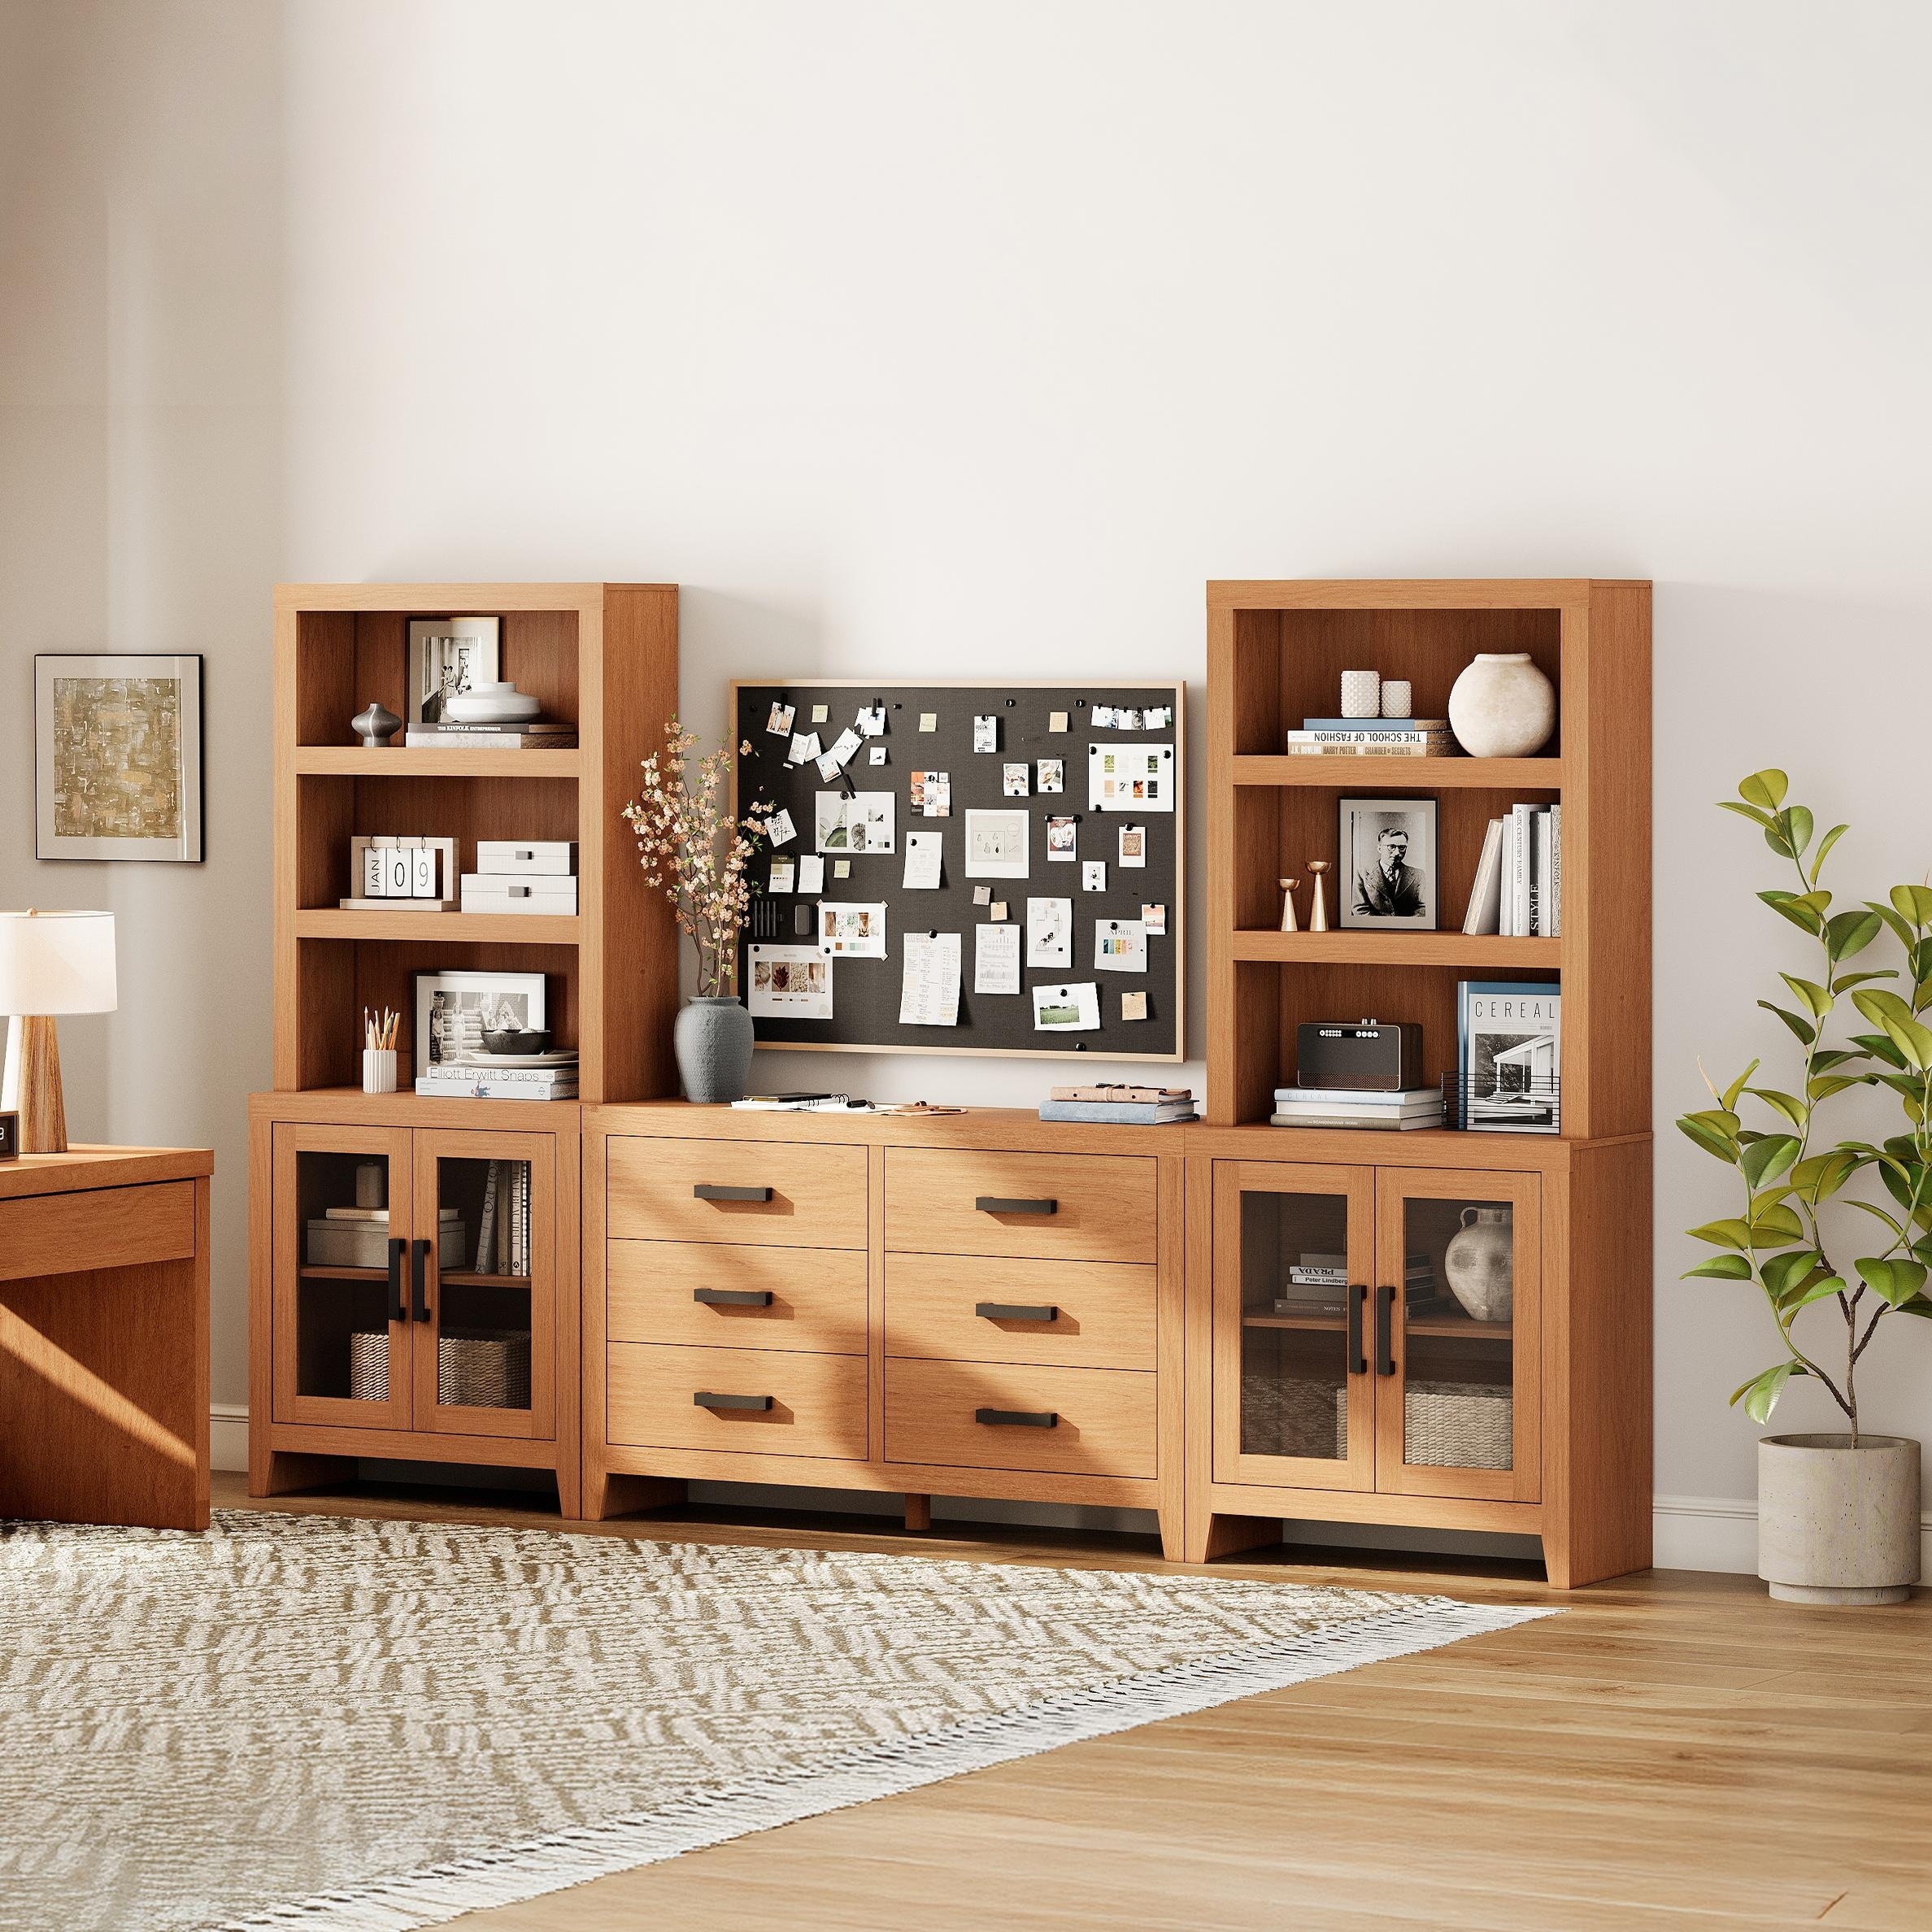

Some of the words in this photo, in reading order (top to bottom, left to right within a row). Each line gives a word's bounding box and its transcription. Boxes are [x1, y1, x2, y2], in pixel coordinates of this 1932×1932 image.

[1314, 733, 1351, 742] FASHION
[1354, 733, 1364, 742] OF
[1367, 733, 1402, 742] SCHOOL
[1404, 733, 1421, 742] THE
[1323, 746, 1338, 755] HARRY
[1339, 746, 1356, 755] POTTER
[372, 859, 380, 893] JAN
[1530, 884, 1538, 930] STYLE
[1475, 1001, 1555, 1019] CEREAL
[430, 1067, 461, 1079] Elliott
[464, 1068, 498, 1081] Erwitt
[501, 1069, 540, 1081] Snaps
